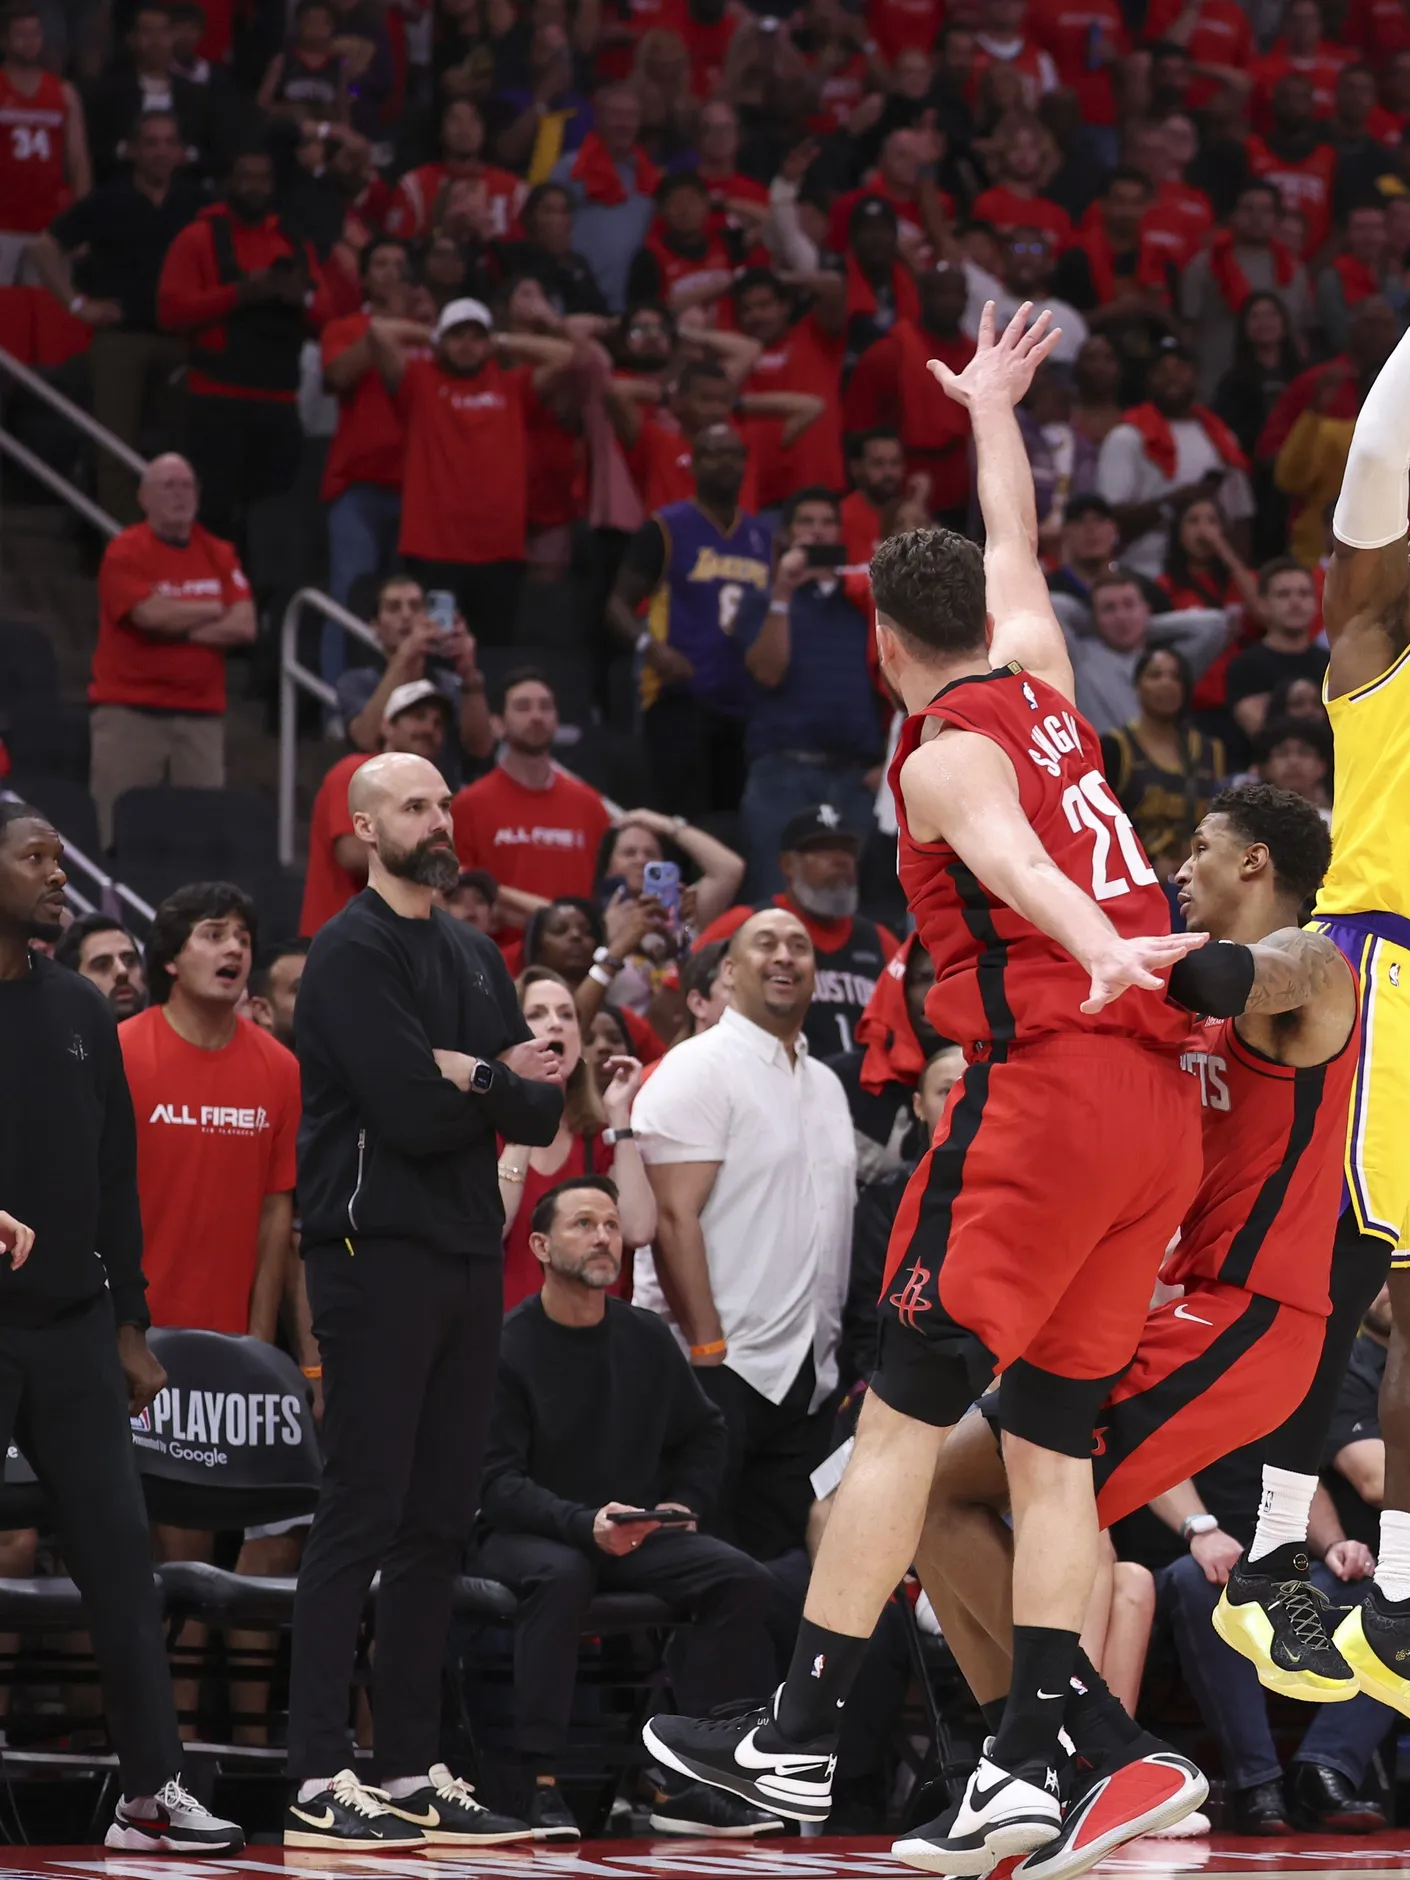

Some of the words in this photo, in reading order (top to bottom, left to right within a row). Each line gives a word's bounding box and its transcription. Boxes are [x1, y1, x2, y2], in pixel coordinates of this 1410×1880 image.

[149, 1103, 198, 1126] ALL
[201, 1105, 256, 1129] FIRE
[153, 1387, 302, 1447] PLAYOFFS
[169, 1441, 228, 1468] Google
